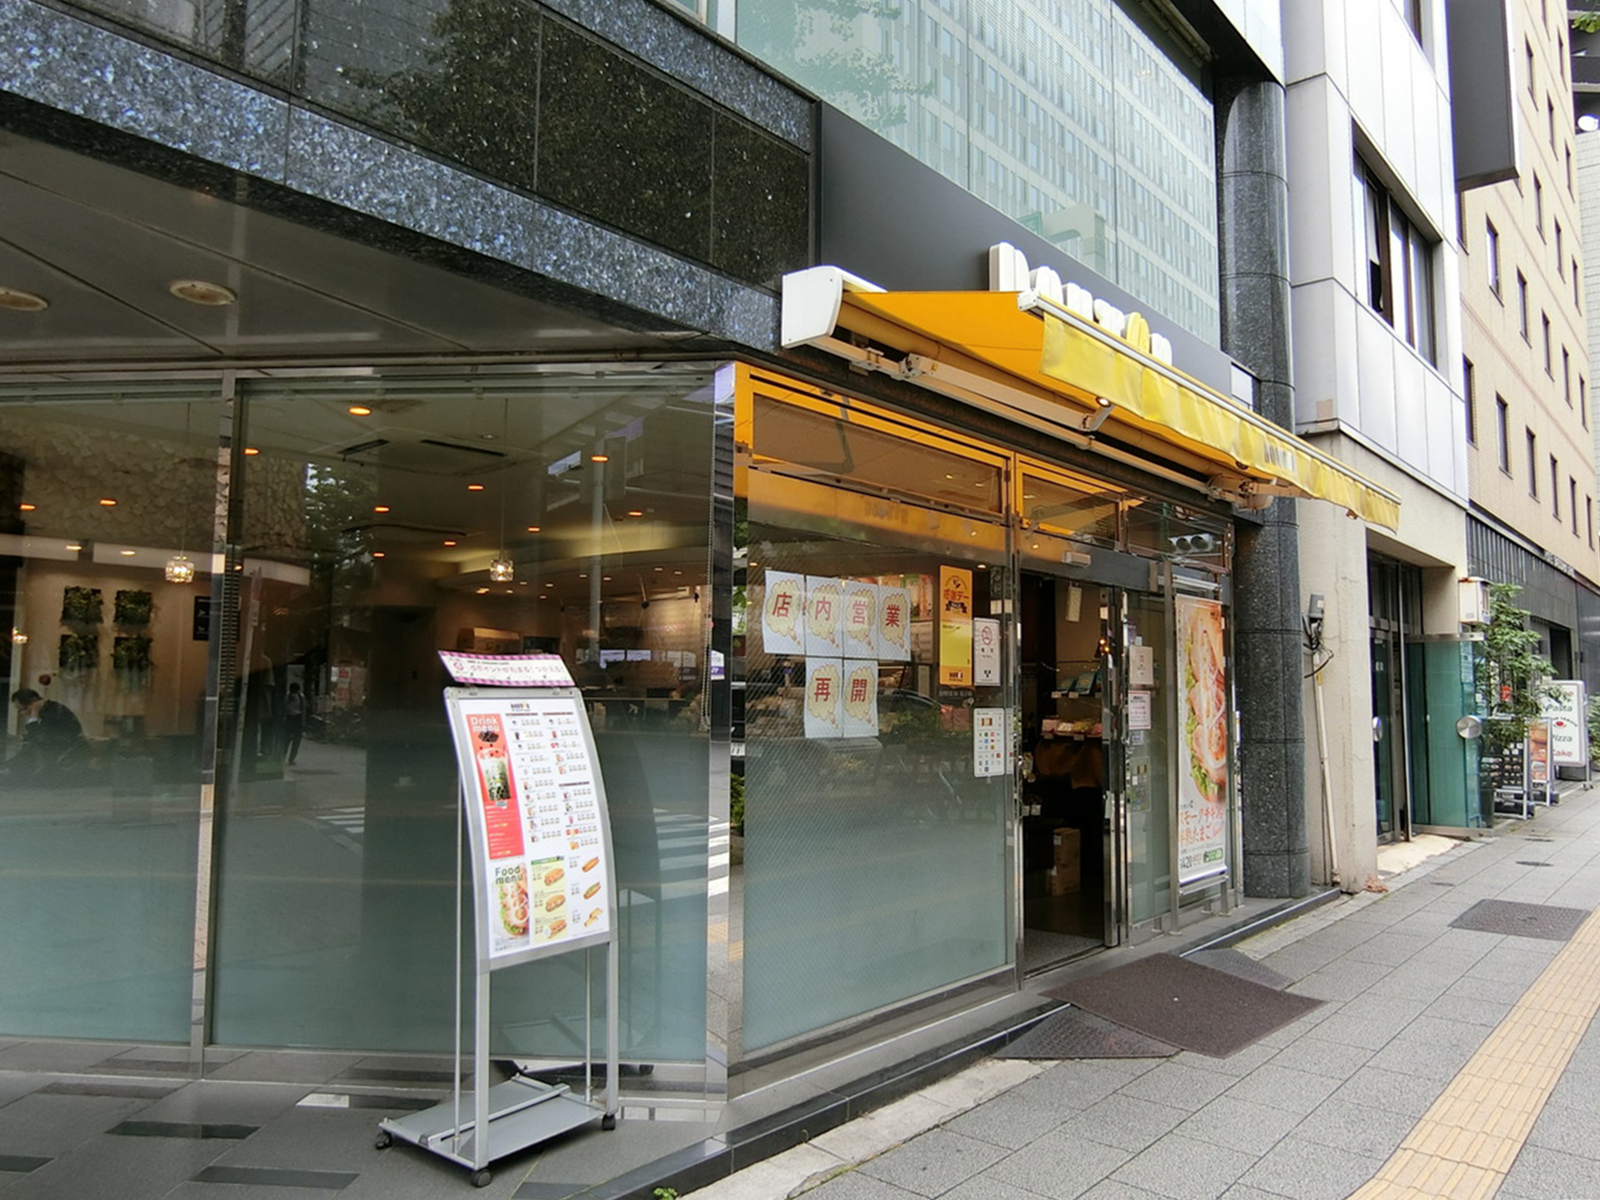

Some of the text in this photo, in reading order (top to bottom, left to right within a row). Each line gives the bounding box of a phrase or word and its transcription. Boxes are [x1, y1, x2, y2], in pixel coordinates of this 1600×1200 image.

[772, 592, 900, 627] 店内営業
[814, 677, 868, 703] 再開
[470, 716, 498, 725] Drink
[473, 724, 500, 732] menu
[495, 864, 521, 877] Food
[496, 873, 524, 885] menu
